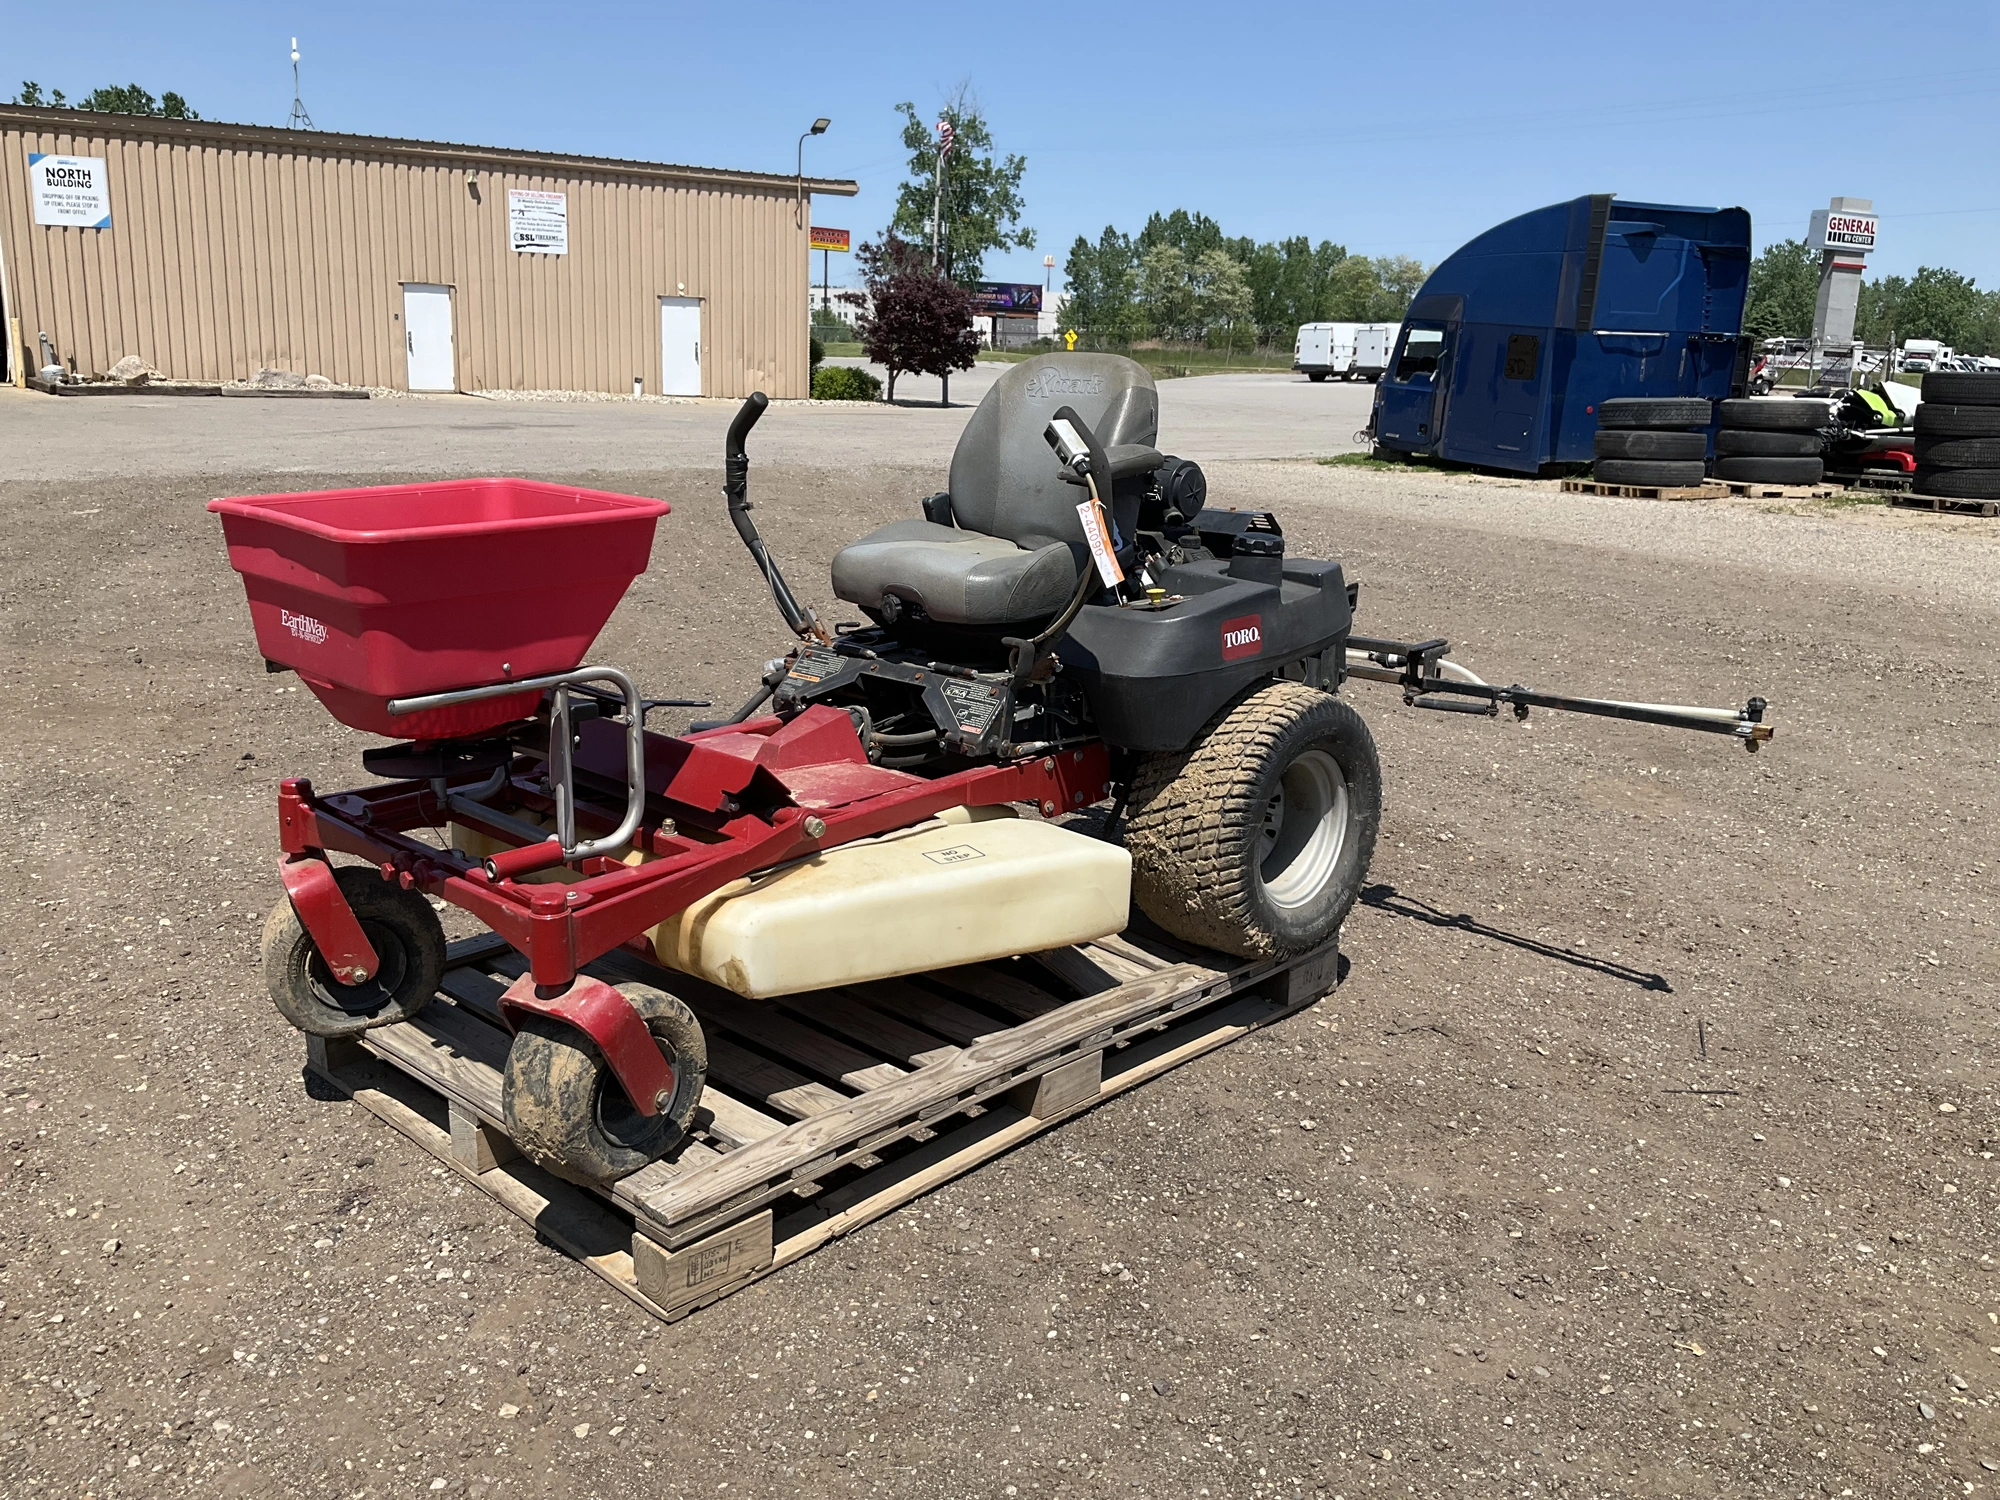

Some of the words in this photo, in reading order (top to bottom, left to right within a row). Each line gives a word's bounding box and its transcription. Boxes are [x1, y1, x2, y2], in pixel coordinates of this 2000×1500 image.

[45, 167, 92, 180] NORTH
[46, 178, 92, 189] BUILDING
[1829, 216, 1876, 235] GENERAL
[519, 233, 535, 242] SSL
[810, 230, 847, 238] PACIFIC
[1843, 234, 1852, 242] RV
[1852, 235, 1872, 244] CENTER
[1079, 505, 1104, 557] 2-44090
[1223, 626, 1259, 649] TORO
[943, 852, 970, 861] STEP
